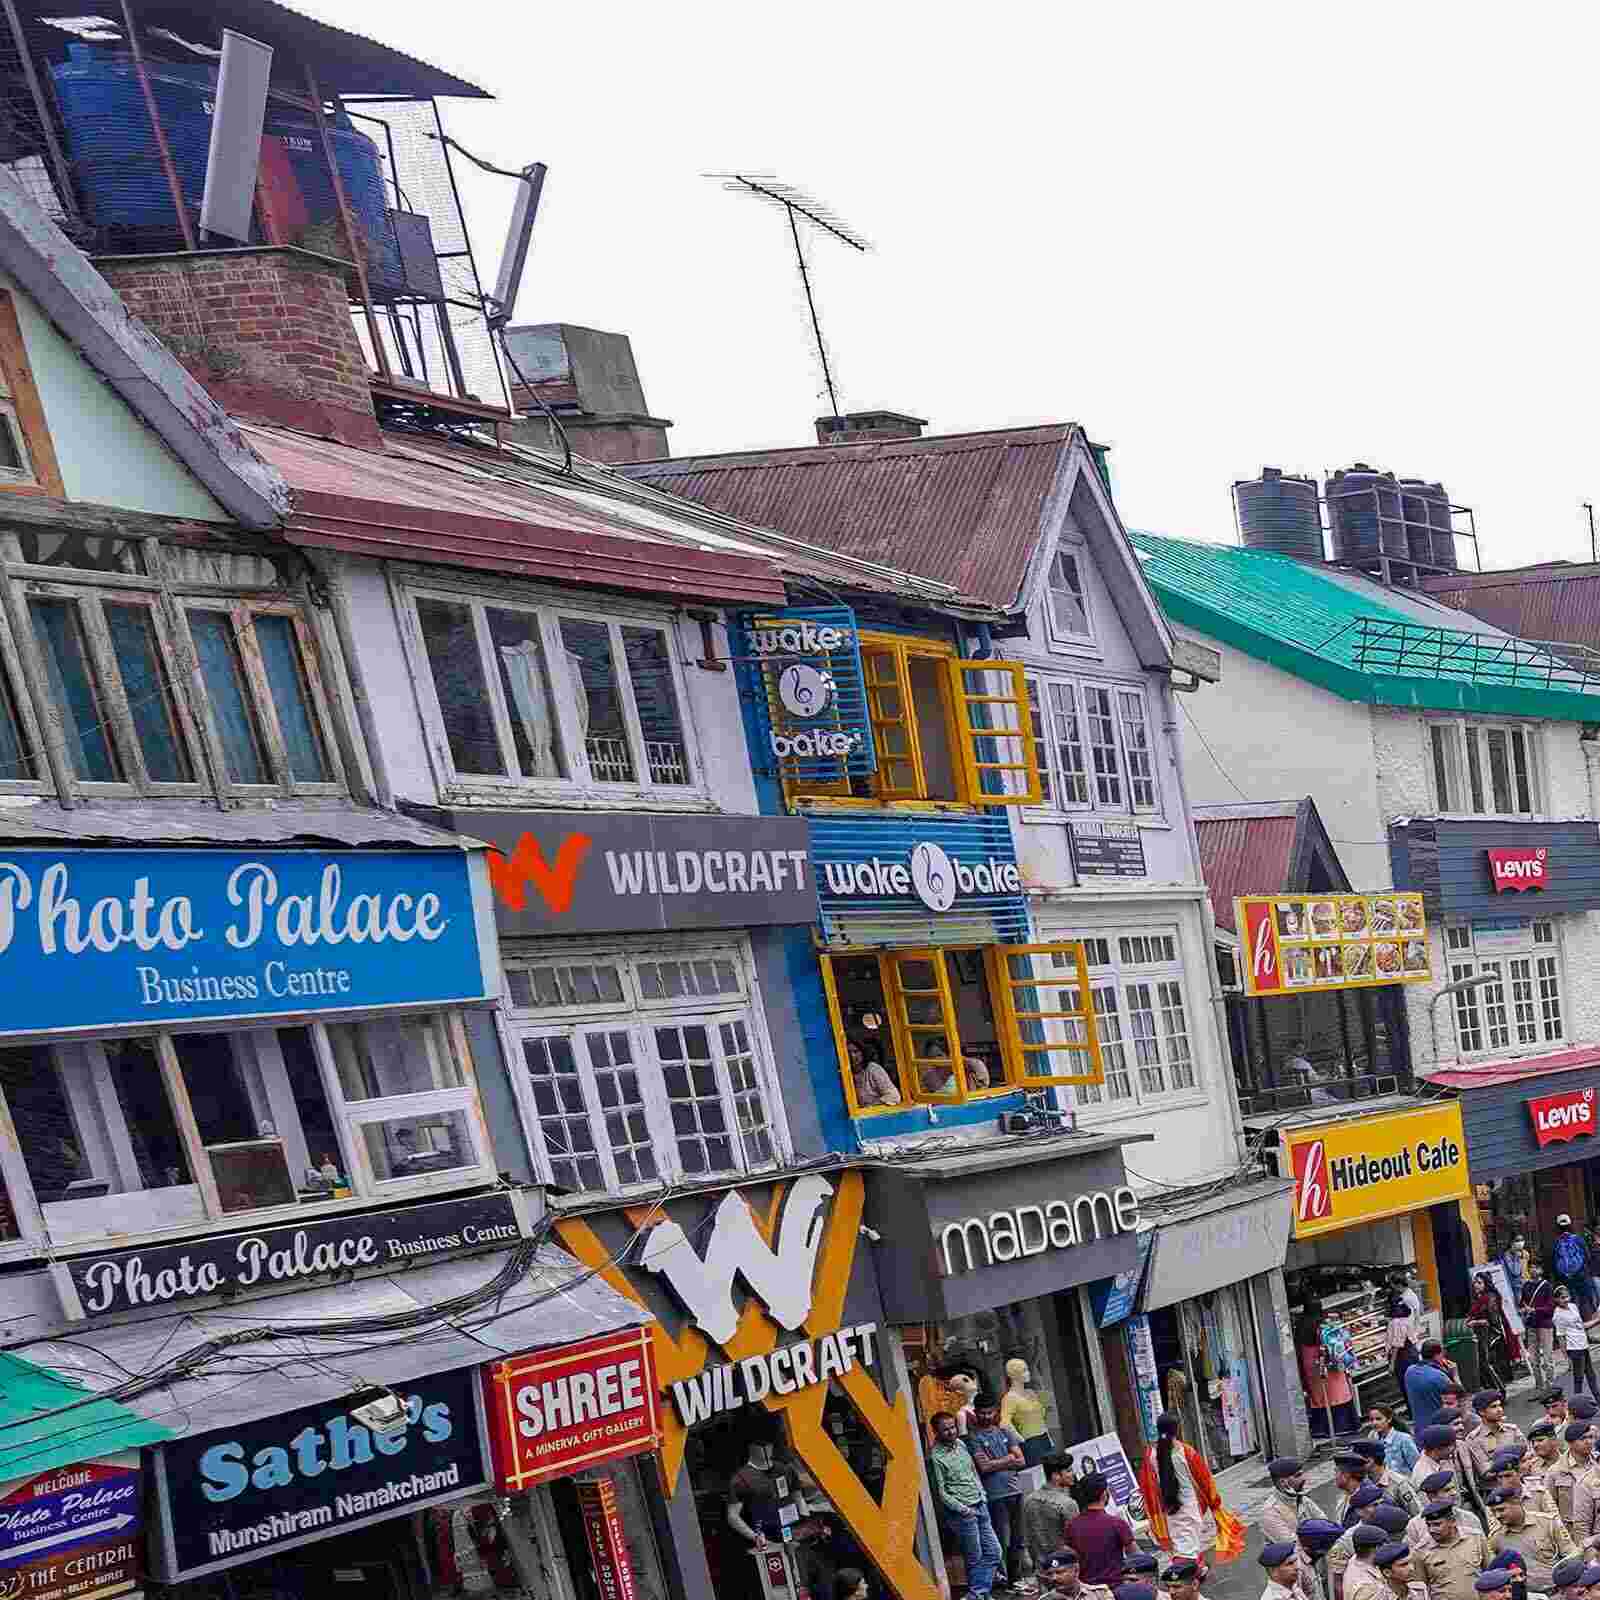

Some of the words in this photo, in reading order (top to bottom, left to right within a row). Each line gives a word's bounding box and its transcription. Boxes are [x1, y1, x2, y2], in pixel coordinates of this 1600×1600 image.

[604, 850, 808, 895] WILDCRAFT
[825, 857, 910, 895] wake
[953, 857, 1020, 893] bake
[0, 862, 204, 955] Photo
[225, 862, 449, 949] Palace
[136, 965, 258, 1005] Business
[264, 961, 351, 998] Centre
[1331, 1150, 1411, 1193] Hideout
[1417, 1137, 1460, 1172] Cafe
[85, 1257, 226, 1312] Photo
[236, 1230, 379, 1285] Palace
[385, 1233, 461, 1259] Business
[463, 1220, 517, 1246] Centre
[672, 1322, 877, 1428] WILDCRAFT
[517, 1359, 644, 1438] SHREE
[526, 1448, 535, 1460] A
[536, 1436, 580, 1458] MINERVA
[583, 1427, 604, 1442] GIFT
[605, 1416, 646, 1436] GALLERY
[33, 1470, 95, 1497] WELCOME
[61, 1484, 136, 1516] Palace
[13, 1519, 67, 1541] Business
[71, 1506, 111, 1525] Centre
[208, 1504, 333, 1556] Munshiram
[335, 1463, 459, 1518] Nanakchand
[30, 1566, 57, 1588] THE
[64, 1543, 136, 1577] CENTRAL
